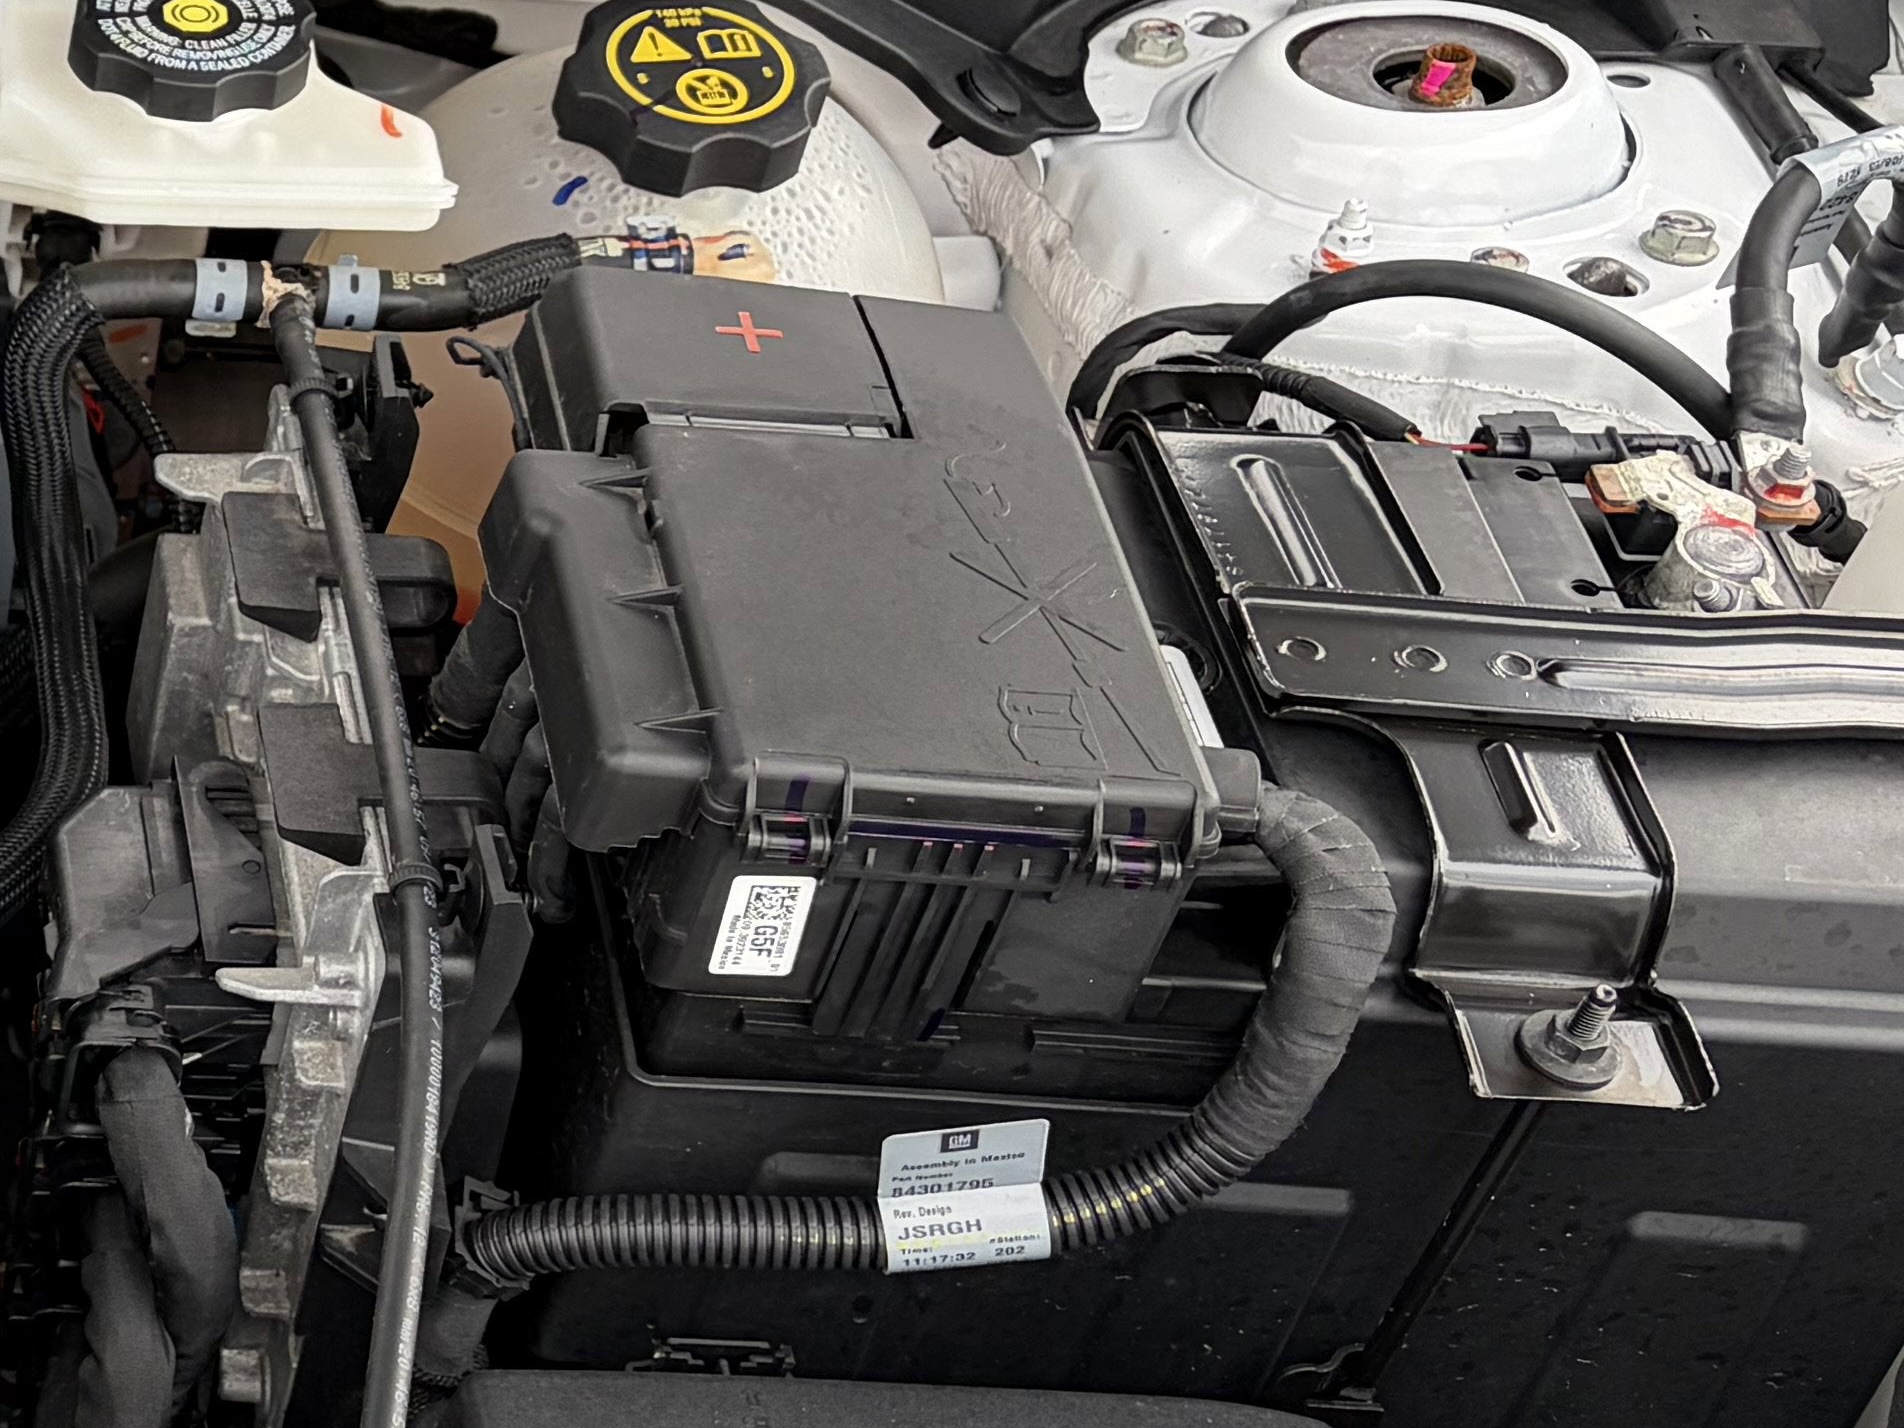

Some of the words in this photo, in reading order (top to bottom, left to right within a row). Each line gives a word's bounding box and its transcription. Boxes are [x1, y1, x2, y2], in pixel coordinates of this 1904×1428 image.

[127, 30, 173, 55] BEFORE
[184, 38, 228, 50] CLEAN
[147, 53, 188, 70] FROM
[187, 61, 198, 71] A
[199, 57, 250, 71] SEALED
[748, 925, 779, 959] G5F
[948, 1132, 973, 1149] GM
[918, 1204, 952, 1218] Design
[897, 1218, 983, 1241] JSRGH
[994, 1245, 1026, 1257] 202
